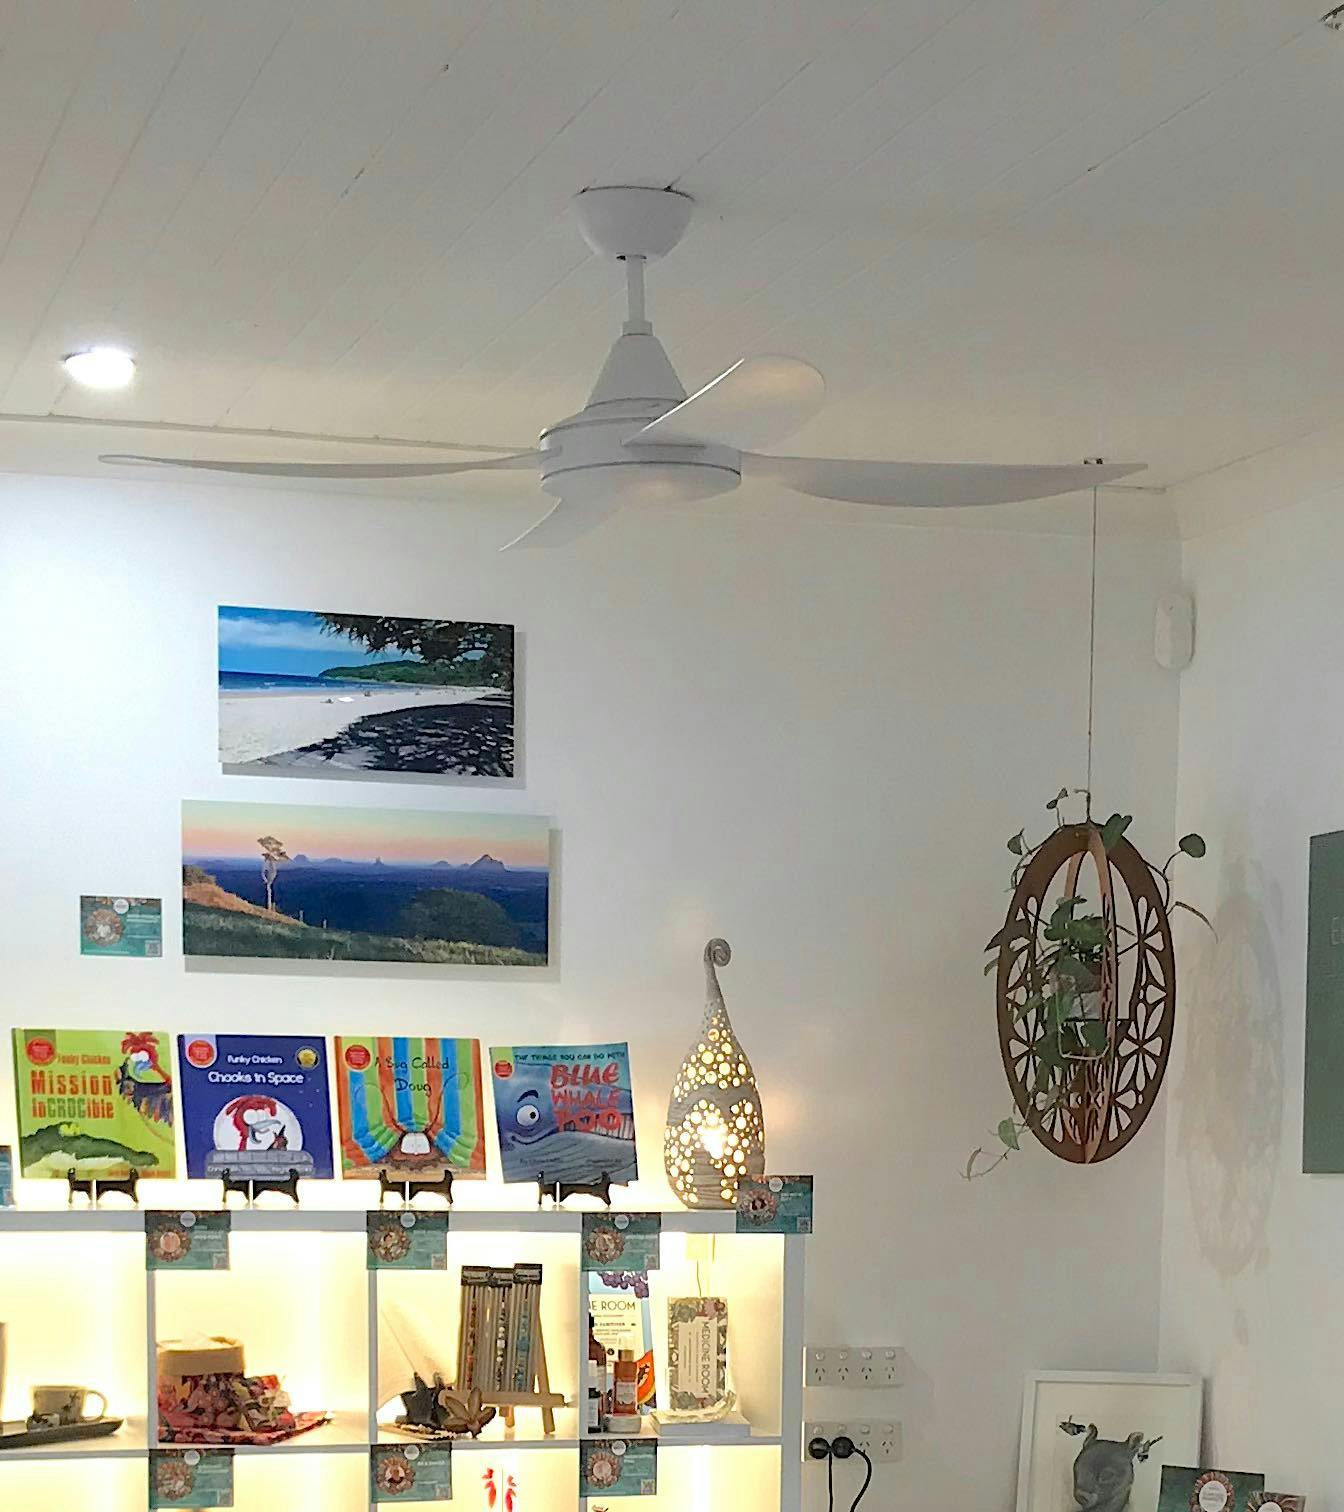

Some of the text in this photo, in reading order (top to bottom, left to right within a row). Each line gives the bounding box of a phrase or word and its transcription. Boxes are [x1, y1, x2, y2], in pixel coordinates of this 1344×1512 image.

[30, 1070, 113, 1095] Mission
[550, 1062, 620, 1089] BLUE
[395, 1077, 432, 1097] Doug
[601, 1300, 636, 1311] ROOM
